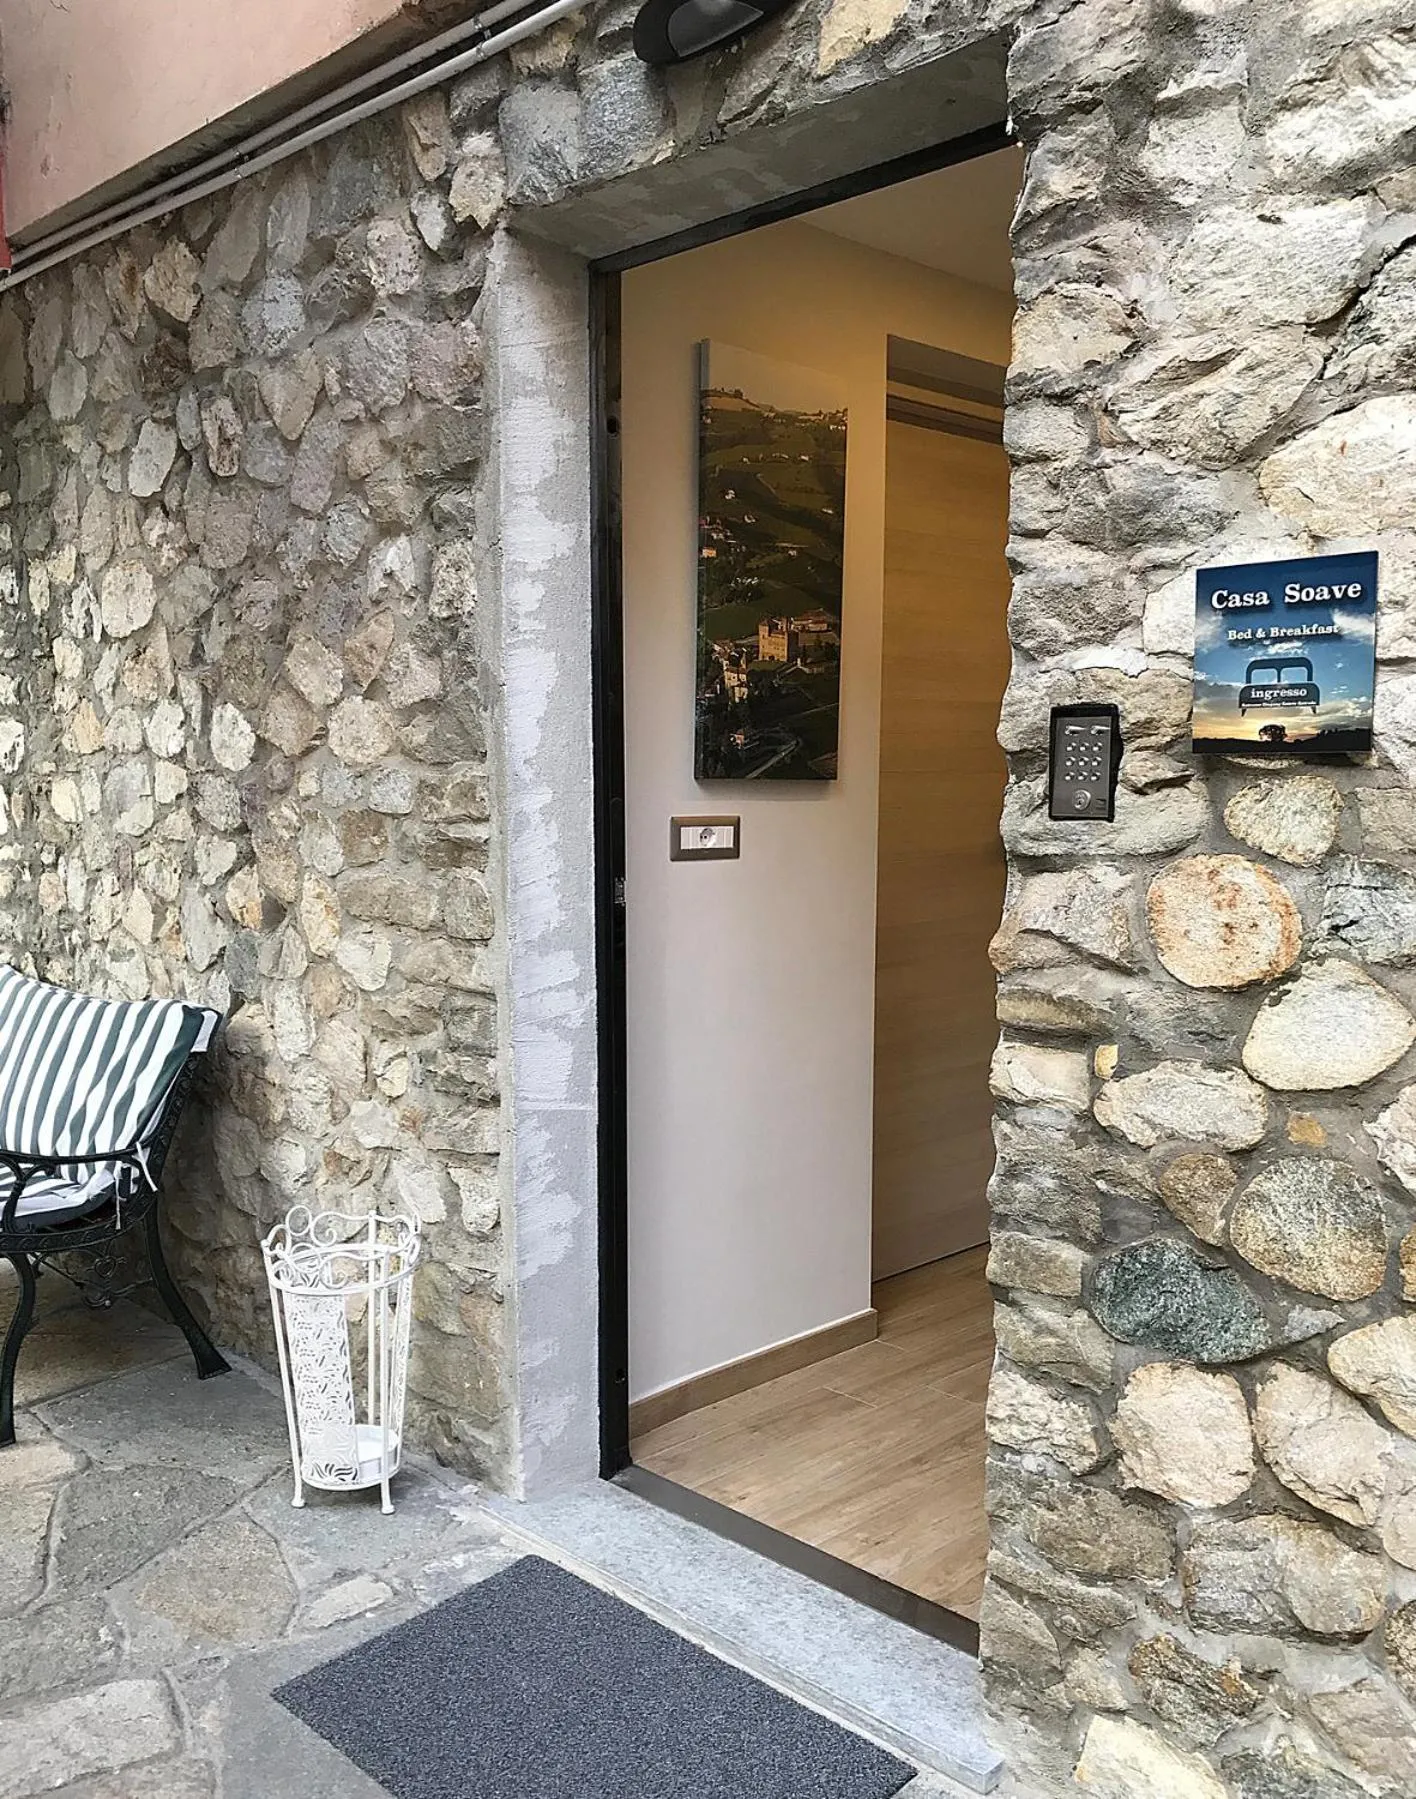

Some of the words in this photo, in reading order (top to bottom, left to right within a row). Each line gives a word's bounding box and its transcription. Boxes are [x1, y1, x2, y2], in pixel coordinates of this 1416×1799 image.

[1211, 589, 1270, 609] Casa
[1284, 582, 1362, 603] Soave
[1227, 628, 1252, 640] Bed
[1255, 628, 1266, 639] &
[1270, 623, 1340, 638] Breakfast
[1250, 688, 1307, 700] ingresso
